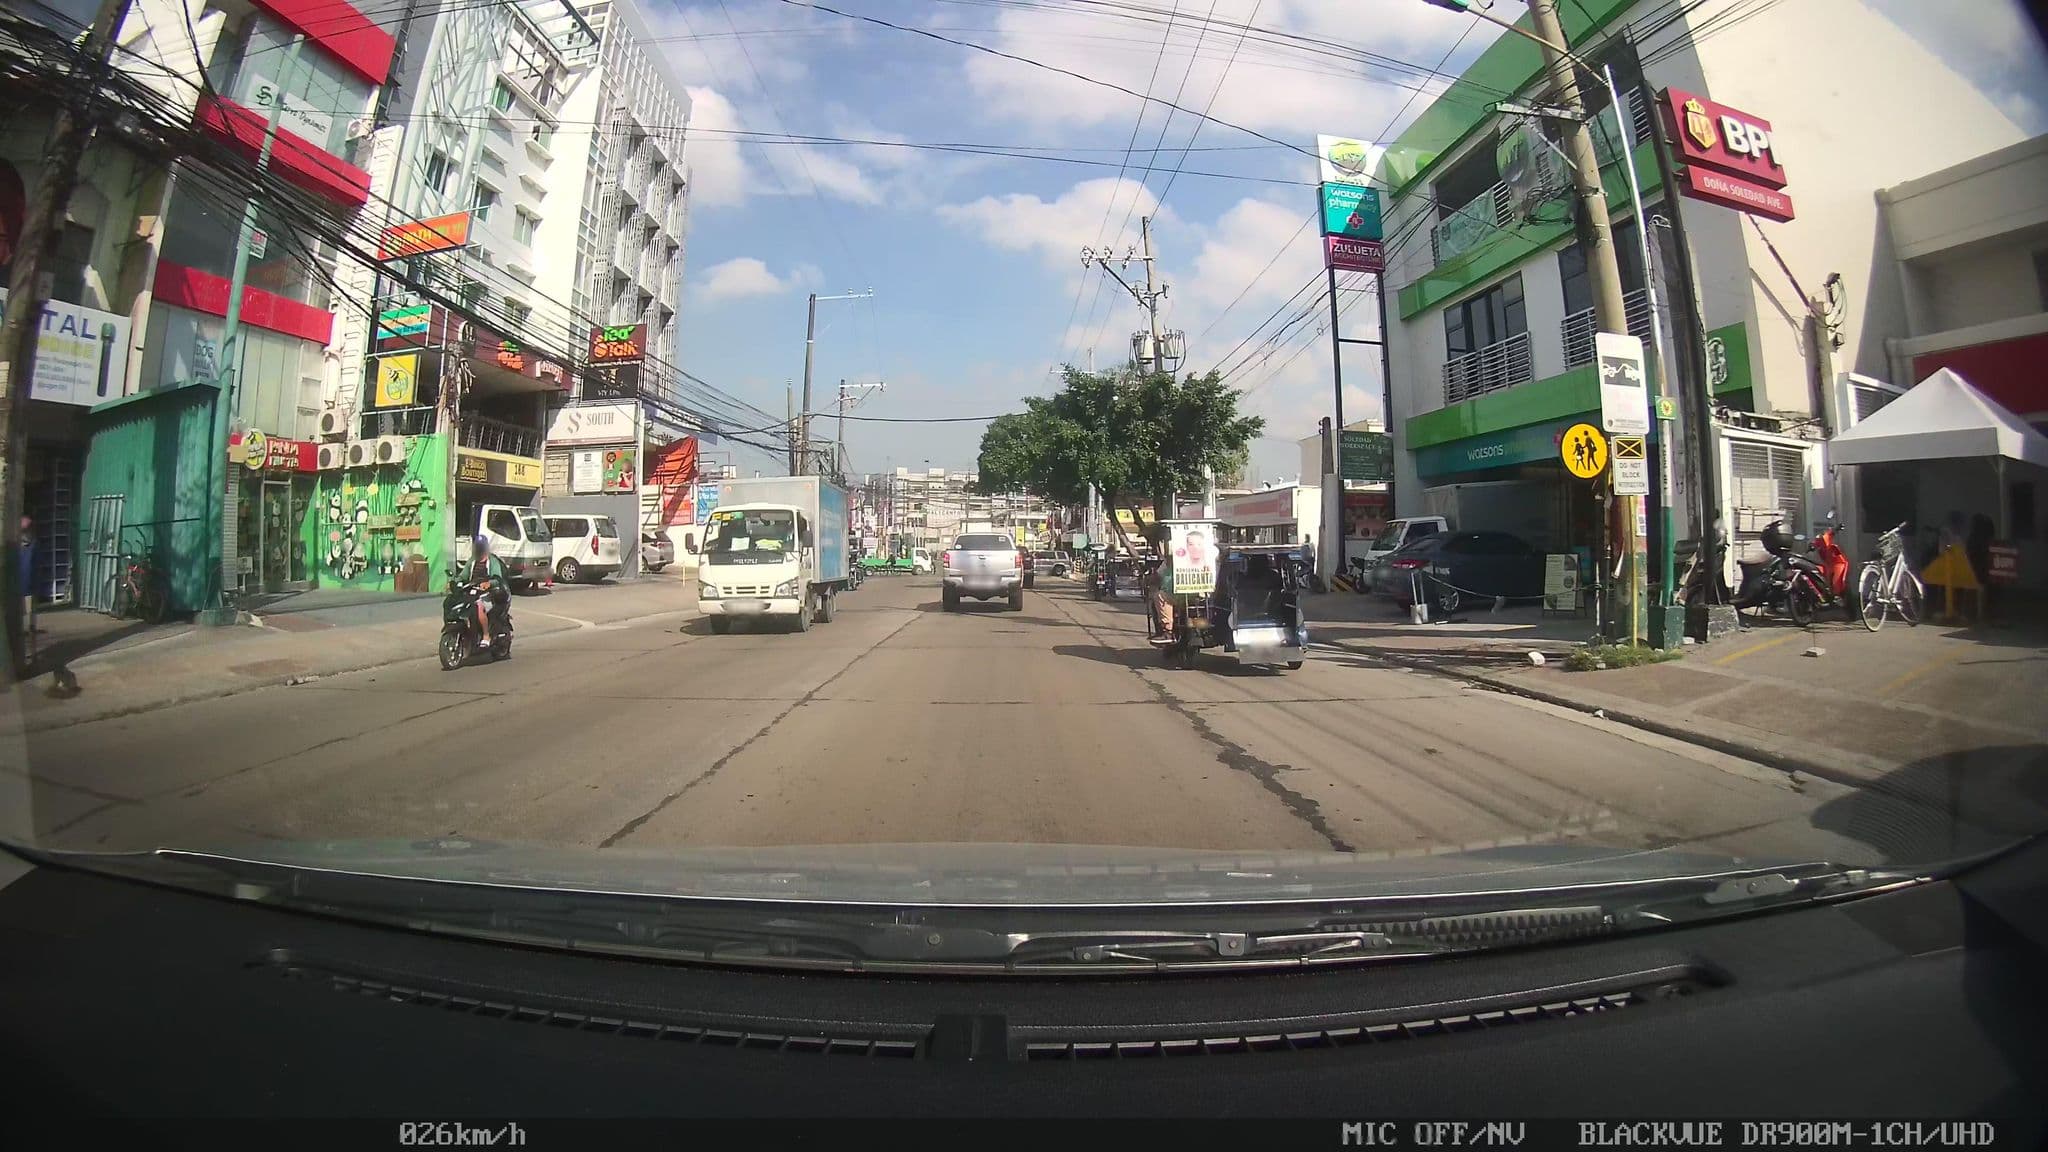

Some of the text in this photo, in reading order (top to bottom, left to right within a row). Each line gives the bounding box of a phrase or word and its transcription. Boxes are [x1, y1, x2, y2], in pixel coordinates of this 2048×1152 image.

[1330, 188, 1375, 202] watsons
[1729, 184, 1766, 203] SOLEDAD
[1333, 243, 1381, 257] ZULUETA
[586, 411, 615, 426] SOUTH
[1467, 444, 1504, 462] watsons
